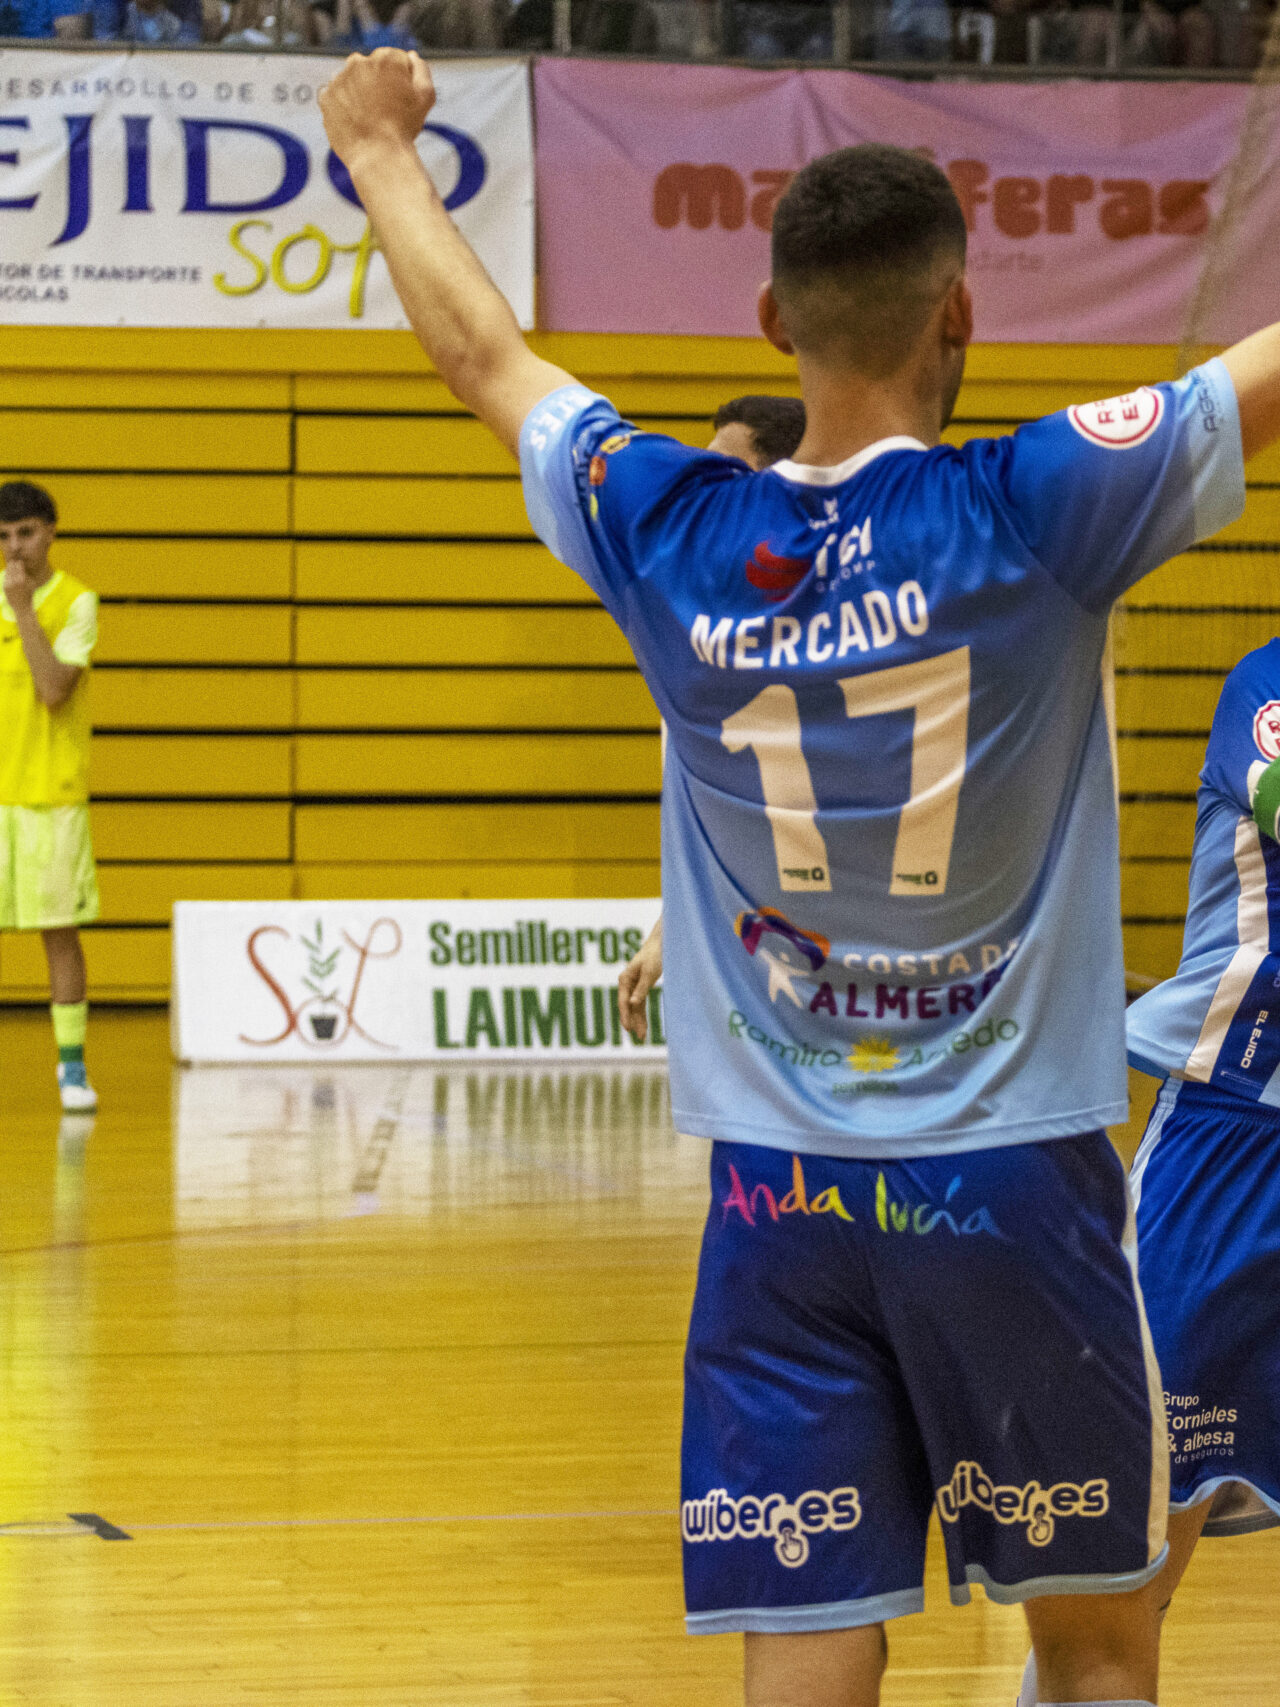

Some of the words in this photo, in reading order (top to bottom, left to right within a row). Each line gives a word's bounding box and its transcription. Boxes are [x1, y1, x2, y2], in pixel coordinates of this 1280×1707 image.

[0, 76, 198, 100] ESARROLLO
[214, 81, 252, 101] DE
[38, 264, 62, 280] DE
[72, 264, 201, 282] TRANSPORTE
[690, 579, 930, 669] MERCADO
[720, 644, 971, 897] 17
[428, 920, 644, 967] Semilleros
[842, 952, 972, 976] COSTA
[1254, 1010, 1271, 1026] EL
[1239, 1028, 1264, 1070] EJIDO
[1162, 1391, 1200, 1410] Grupo
[1183, 1430, 1235, 1452] albesa
[1174, 1453, 1189, 1464] de
[1190, 1447, 1235, 1462] seguros
[681, 1486, 863, 1550] wiber.es
